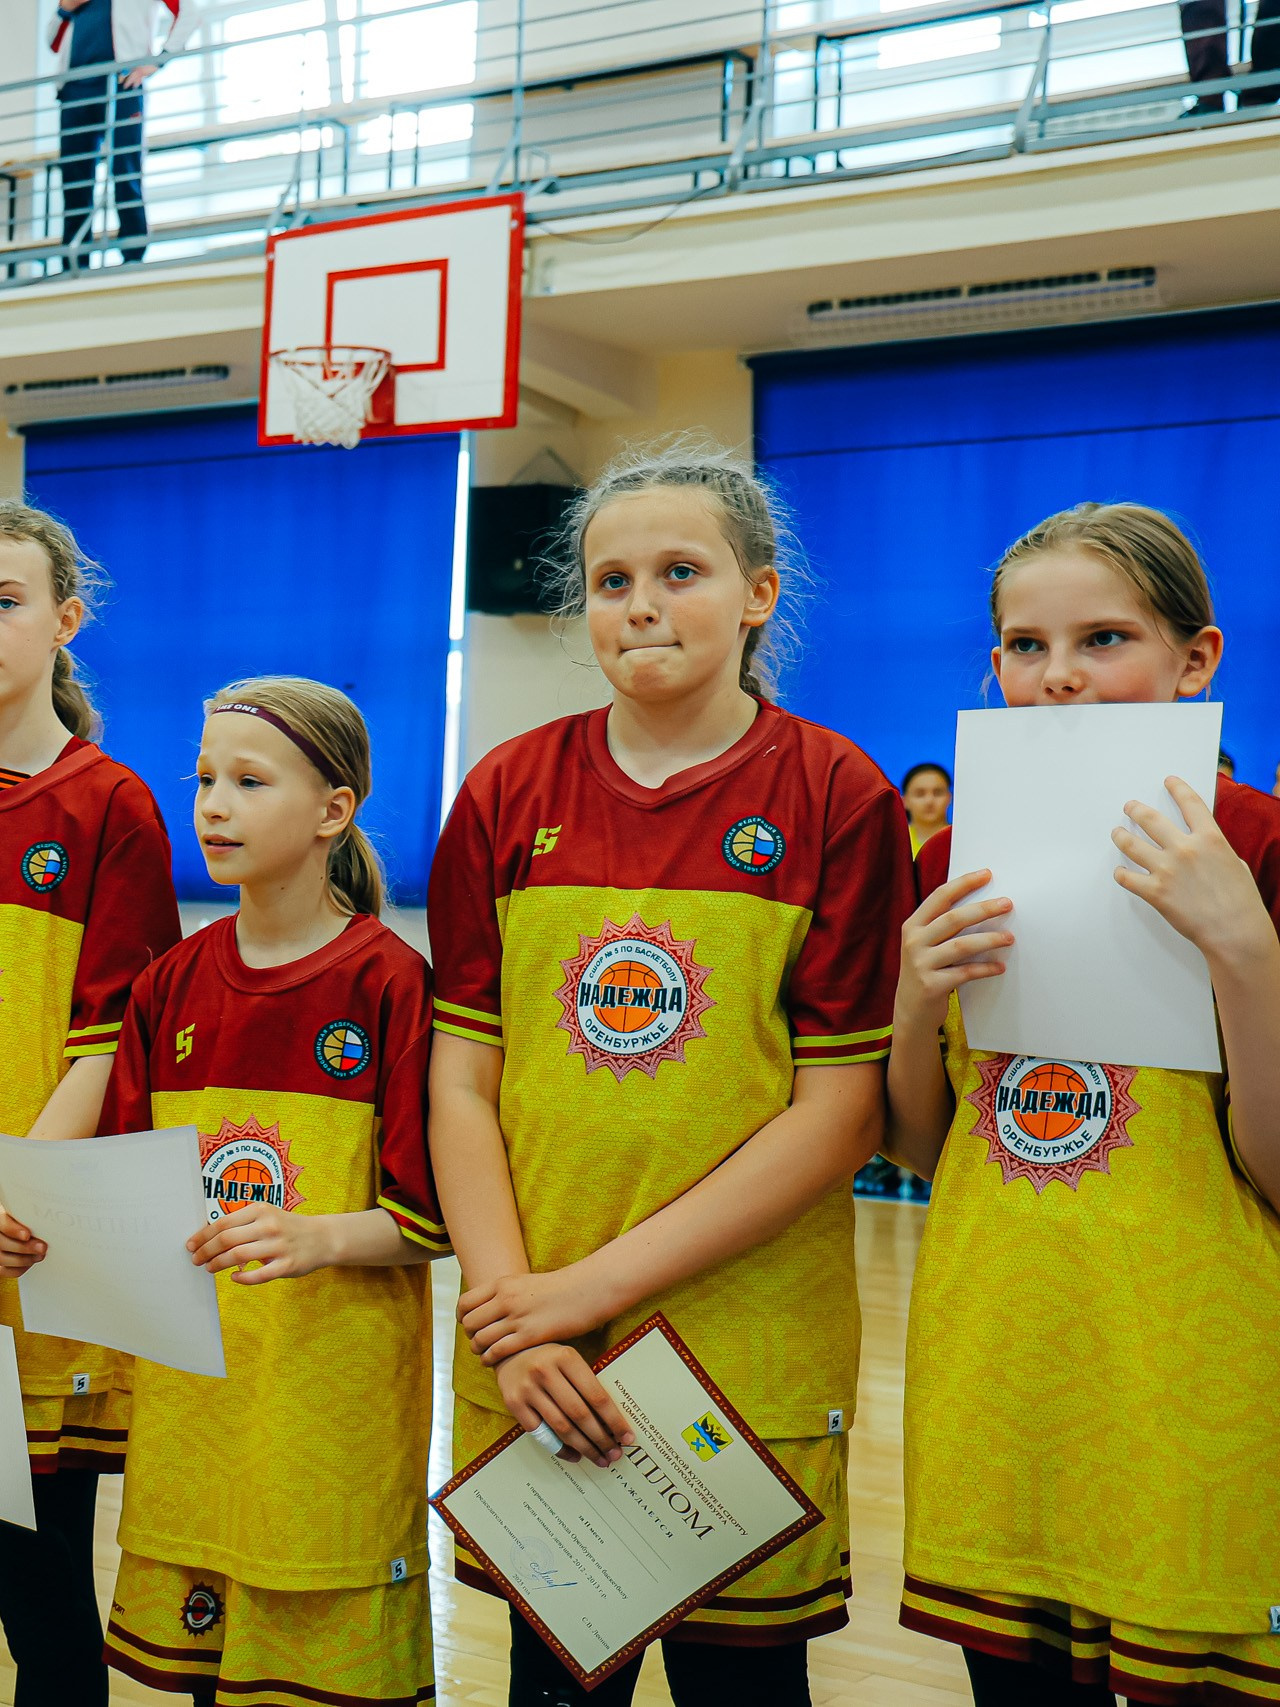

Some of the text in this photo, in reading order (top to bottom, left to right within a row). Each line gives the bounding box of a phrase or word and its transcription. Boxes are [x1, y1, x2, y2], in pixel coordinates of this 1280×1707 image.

[589, 956, 604, 979] СШОР
[635, 946, 678, 982] БАСКЕТБОЛУ
[579, 982, 682, 1013] НАДЕЖДА
[585, 1018, 669, 1048] ОРЕНБУРЖЬЕ
[997, 1086, 1107, 1120] НАДЕЖДА
[1002, 1124, 1092, 1157] ОРЕНБУРЖЬЕ
[203, 1176, 282, 1207] НАДЕЖДА
[612, 1378, 643, 1414] КОМИТЕТ
[638, 1412, 650, 1425] ПО
[647, 1423, 689, 1471] ФИЗИЧЕСКОЙ
[686, 1469, 719, 1505] КУЛЬТУРЕ
[721, 1508, 748, 1538] СПОРТУ
[618, 1400, 728, 1526] АДМИНИСТРАЦИИ ГОРОДА ОРЕНБУРГА
[607, 1464, 674, 1540] ГРАЖДАЕТСЯ
[618, 1441, 715, 1542] ИПЛОМ
[552, 1514, 572, 1535] города
[569, 1532, 597, 1564] Оренбурга
[594, 1561, 602, 1570] по
[599, 1568, 629, 1601] баскетболу
[571, 1557, 586, 1573] 2012
[586, 1574, 600, 1590] 2013
